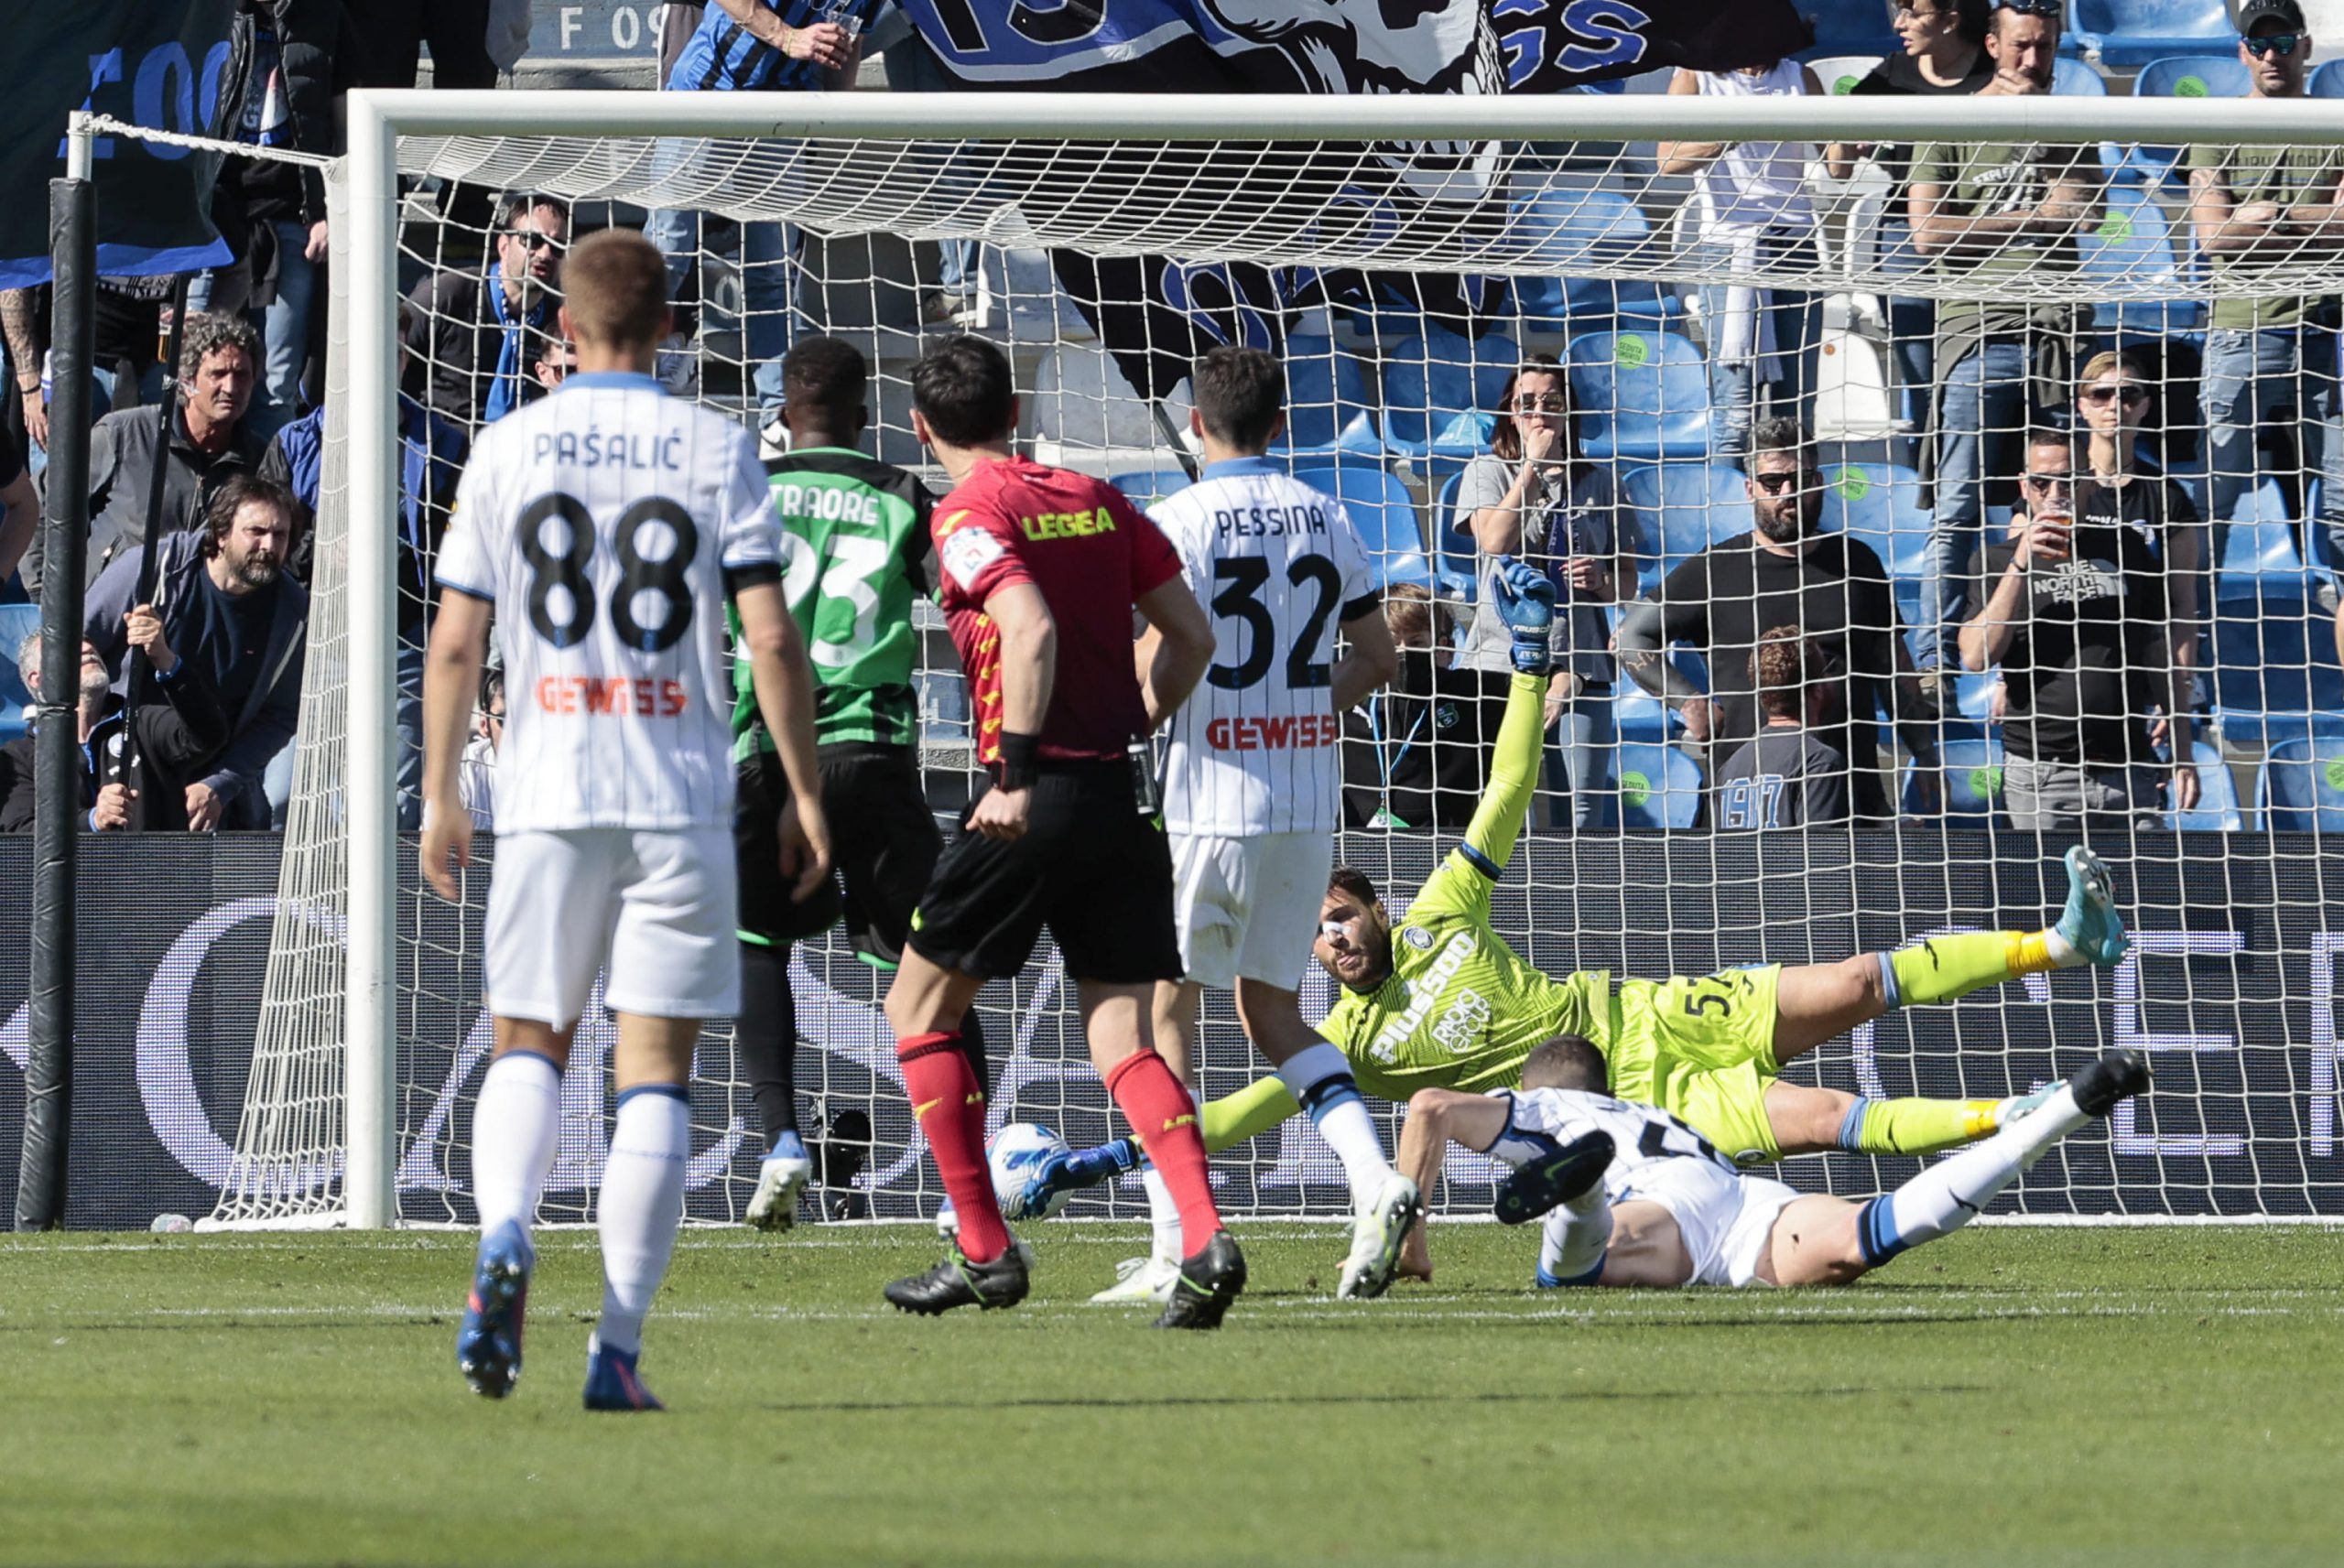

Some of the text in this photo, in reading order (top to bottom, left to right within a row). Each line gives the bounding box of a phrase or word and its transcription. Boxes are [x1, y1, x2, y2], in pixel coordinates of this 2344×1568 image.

[560, 6, 583, 50] F
[535, 424, 681, 470] PAŠALIĆ
[1021, 506, 1116, 542] LEGEA
[1215, 505, 1326, 538] PESSINA
[515, 491, 699, 653] 88
[2034, 574, 2094, 595] NORTH
[2054, 559, 2089, 575] THE
[2052, 586, 2098, 605] FACE
[1206, 554, 1342, 690] 32
[1431, 987, 1482, 1047] RADIO
